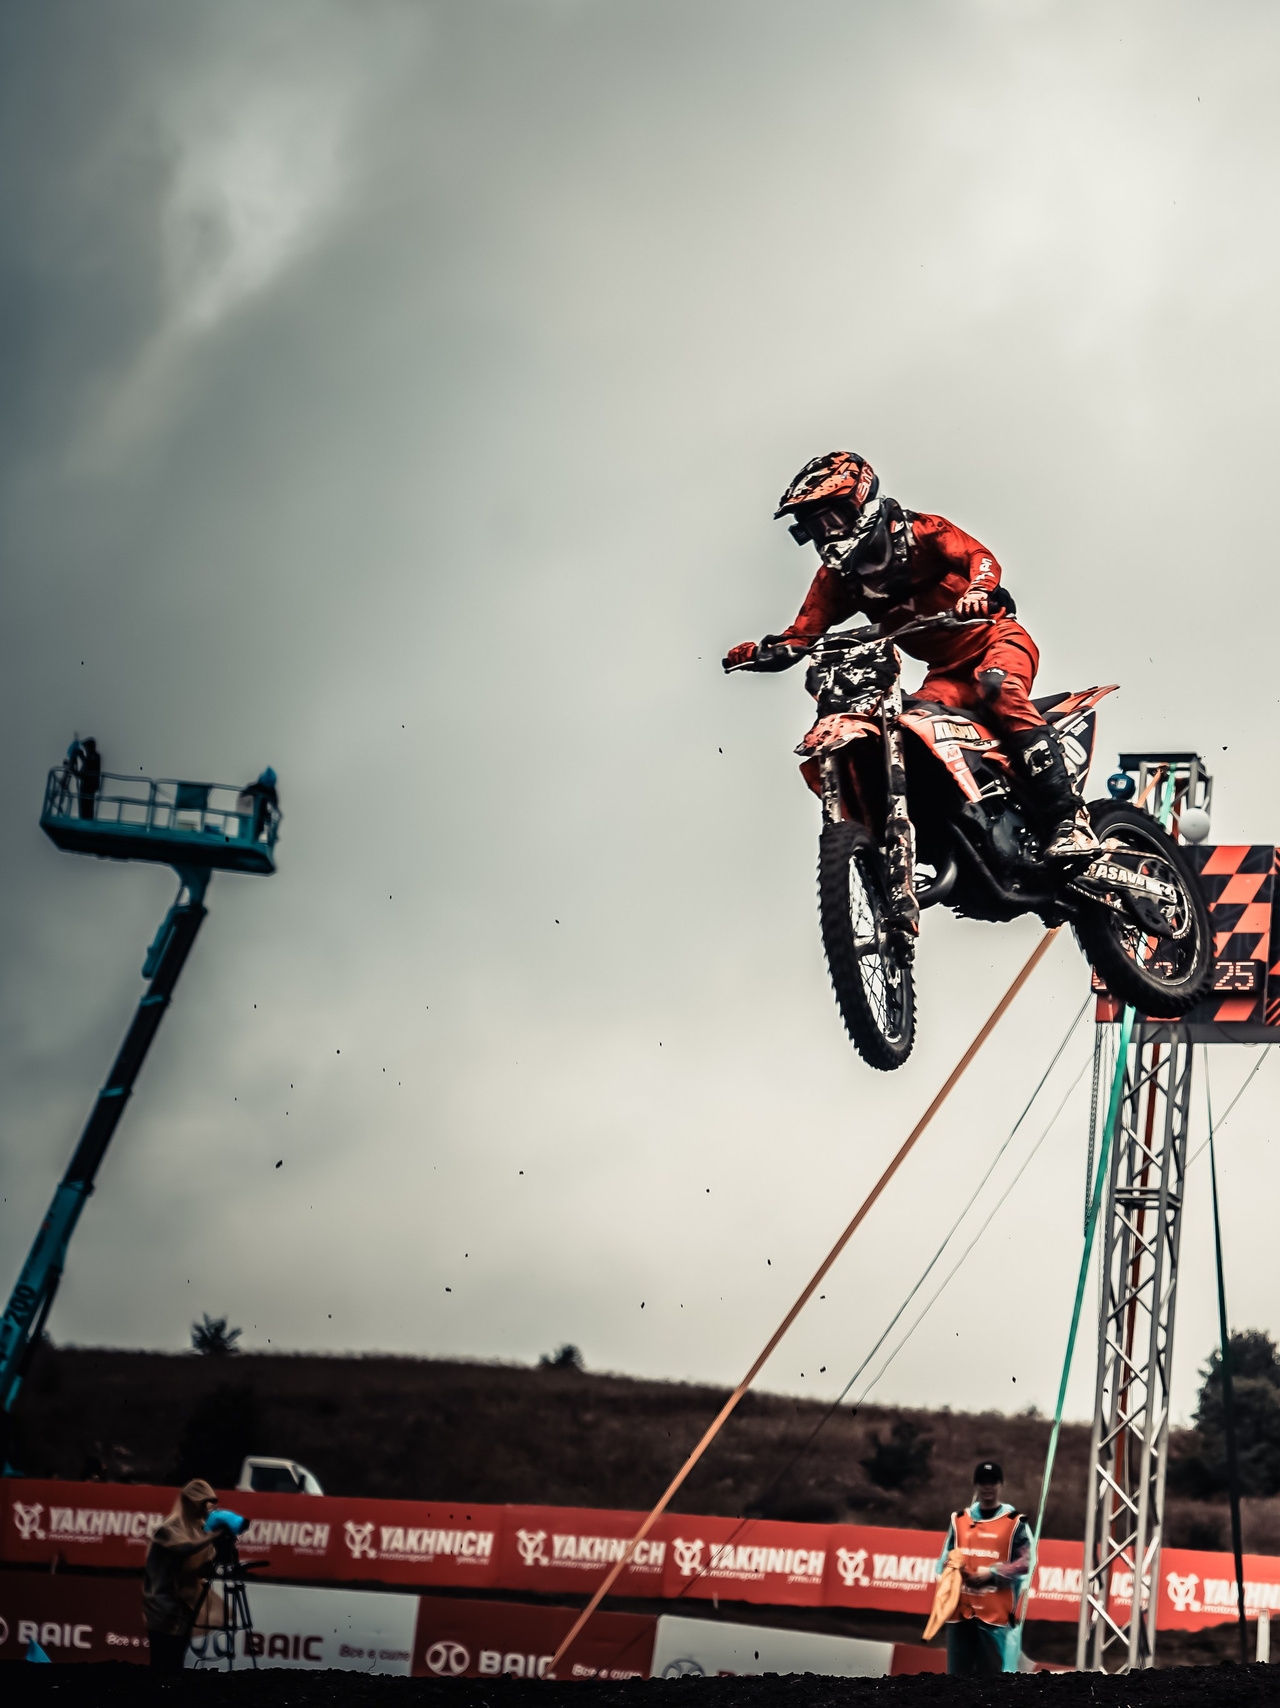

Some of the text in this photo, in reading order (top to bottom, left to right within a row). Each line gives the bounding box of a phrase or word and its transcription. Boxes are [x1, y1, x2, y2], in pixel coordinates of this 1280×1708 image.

[1214, 961, 1255, 990] 25
[238, 1519, 330, 1549] KHNICH
[380, 1526, 494, 1557] YAKHNICH
[709, 1543, 826, 1576] YAKHNICH
[873, 1553, 938, 1584] YAKH
[1039, 1566, 1152, 1599] YAKIC
[18, 1620, 93, 1649] BAIC
[243, 1631, 324, 1662] BAIC
